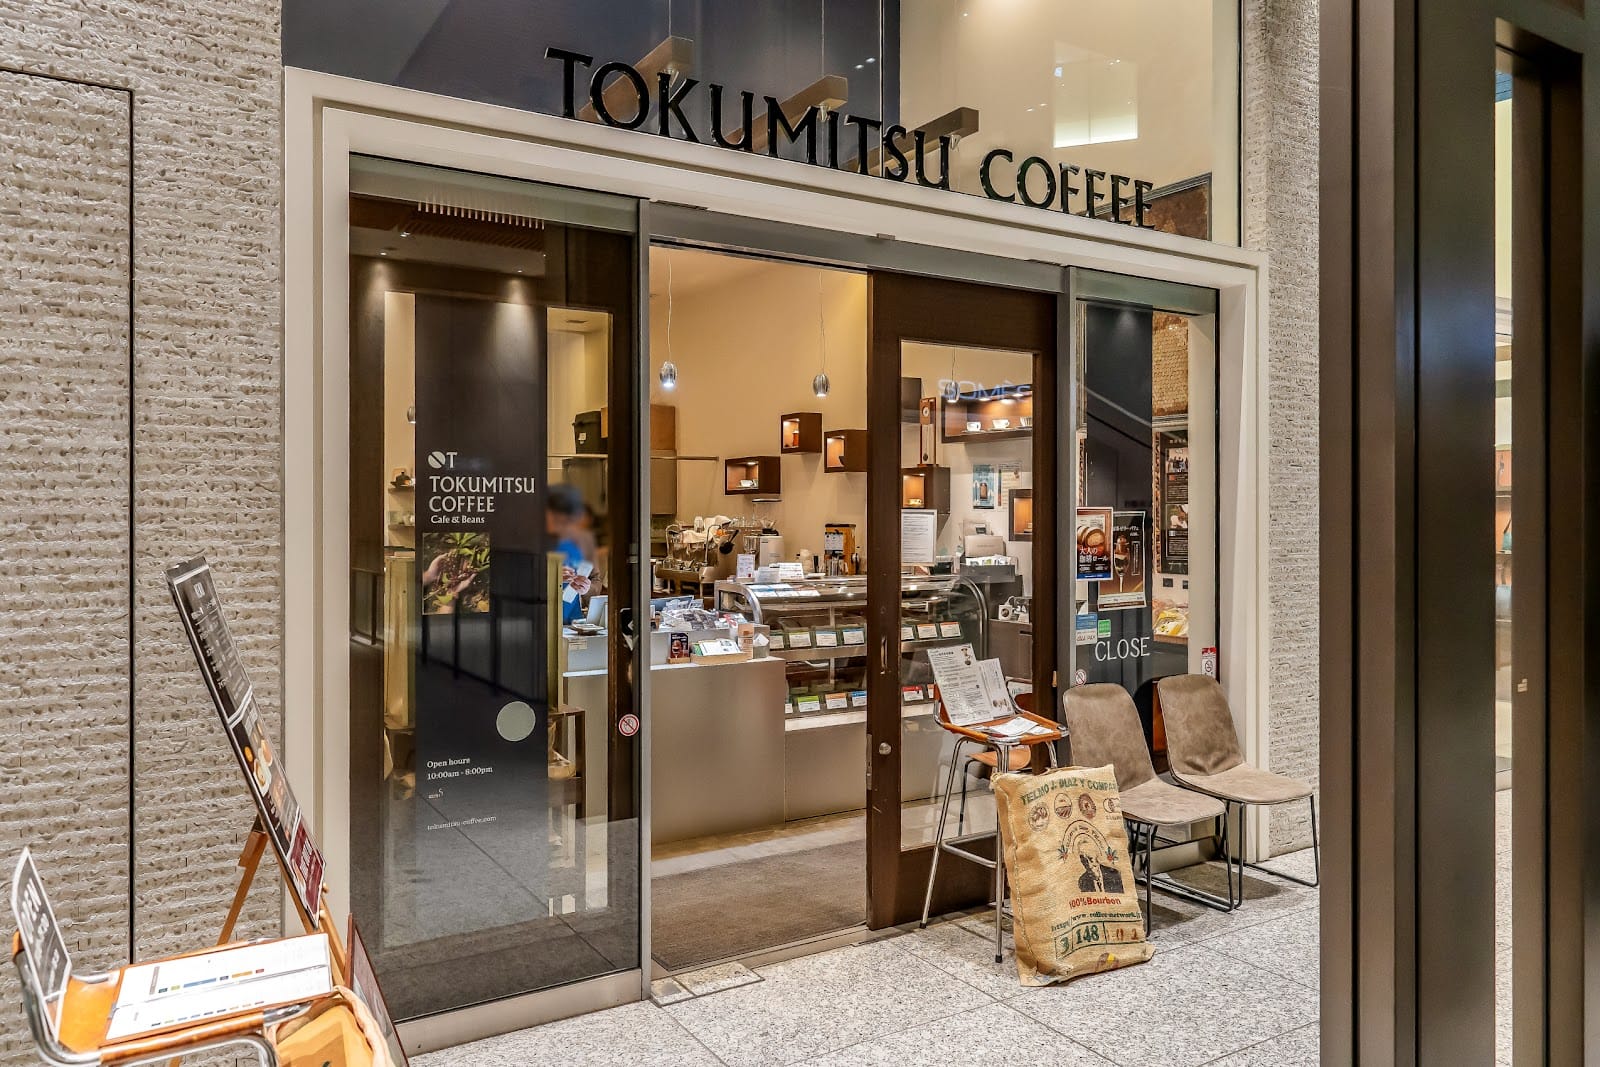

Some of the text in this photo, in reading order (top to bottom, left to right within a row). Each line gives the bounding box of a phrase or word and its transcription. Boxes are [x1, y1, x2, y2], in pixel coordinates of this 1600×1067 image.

[544, 46, 1156, 230] TOKUMITSU COFFEE
[429, 475, 535, 494] TOKUMITSU
[428, 495, 495, 513] COFFEE
[461, 515, 485, 524] Beans
[1095, 637, 1150, 661] CLOSE
[426, 760, 448, 769] Open
[427, 771, 460, 781] 10:00am
[1075, 924, 1100, 945] 148
